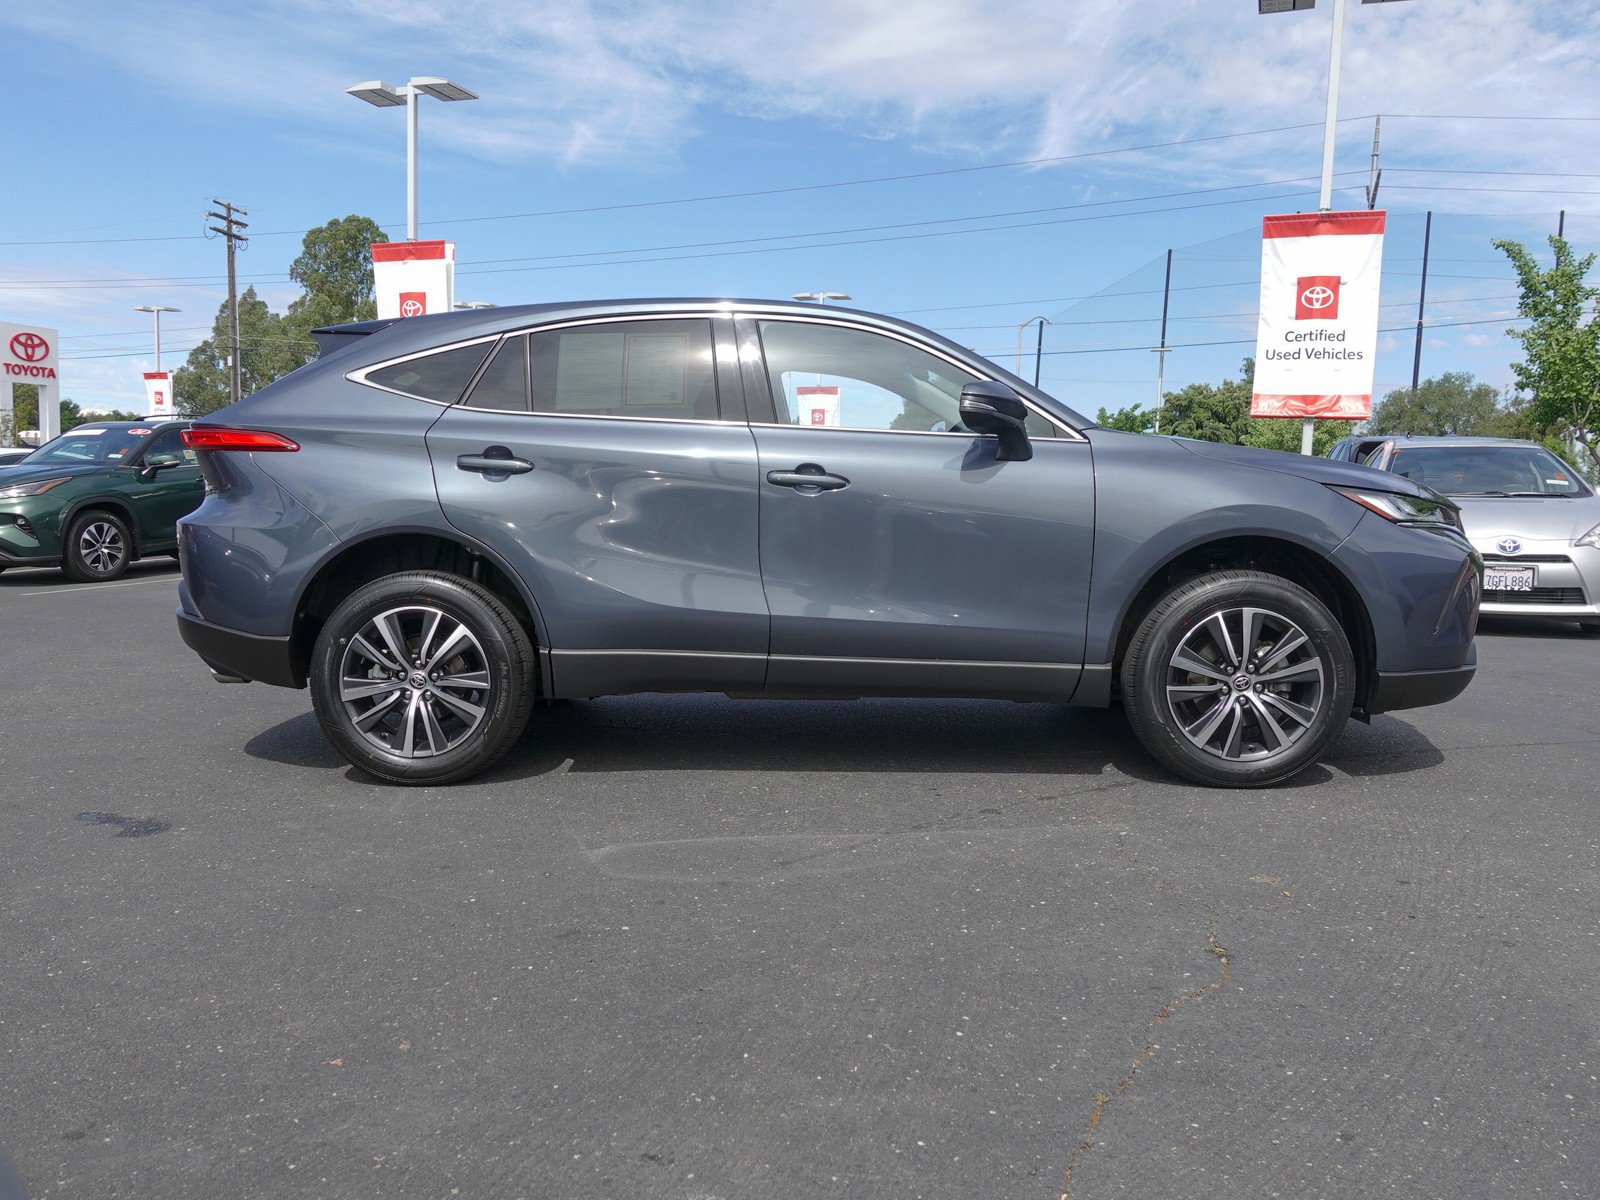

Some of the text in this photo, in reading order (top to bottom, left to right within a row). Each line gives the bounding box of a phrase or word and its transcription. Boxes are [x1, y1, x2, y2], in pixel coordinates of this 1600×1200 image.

[1284, 329, 1346, 342] Certified
[1265, 347, 1364, 360] Used Vehicles
[3, 362, 57, 379] TOYOTA
[1486, 575, 1531, 587] 7GFL886
